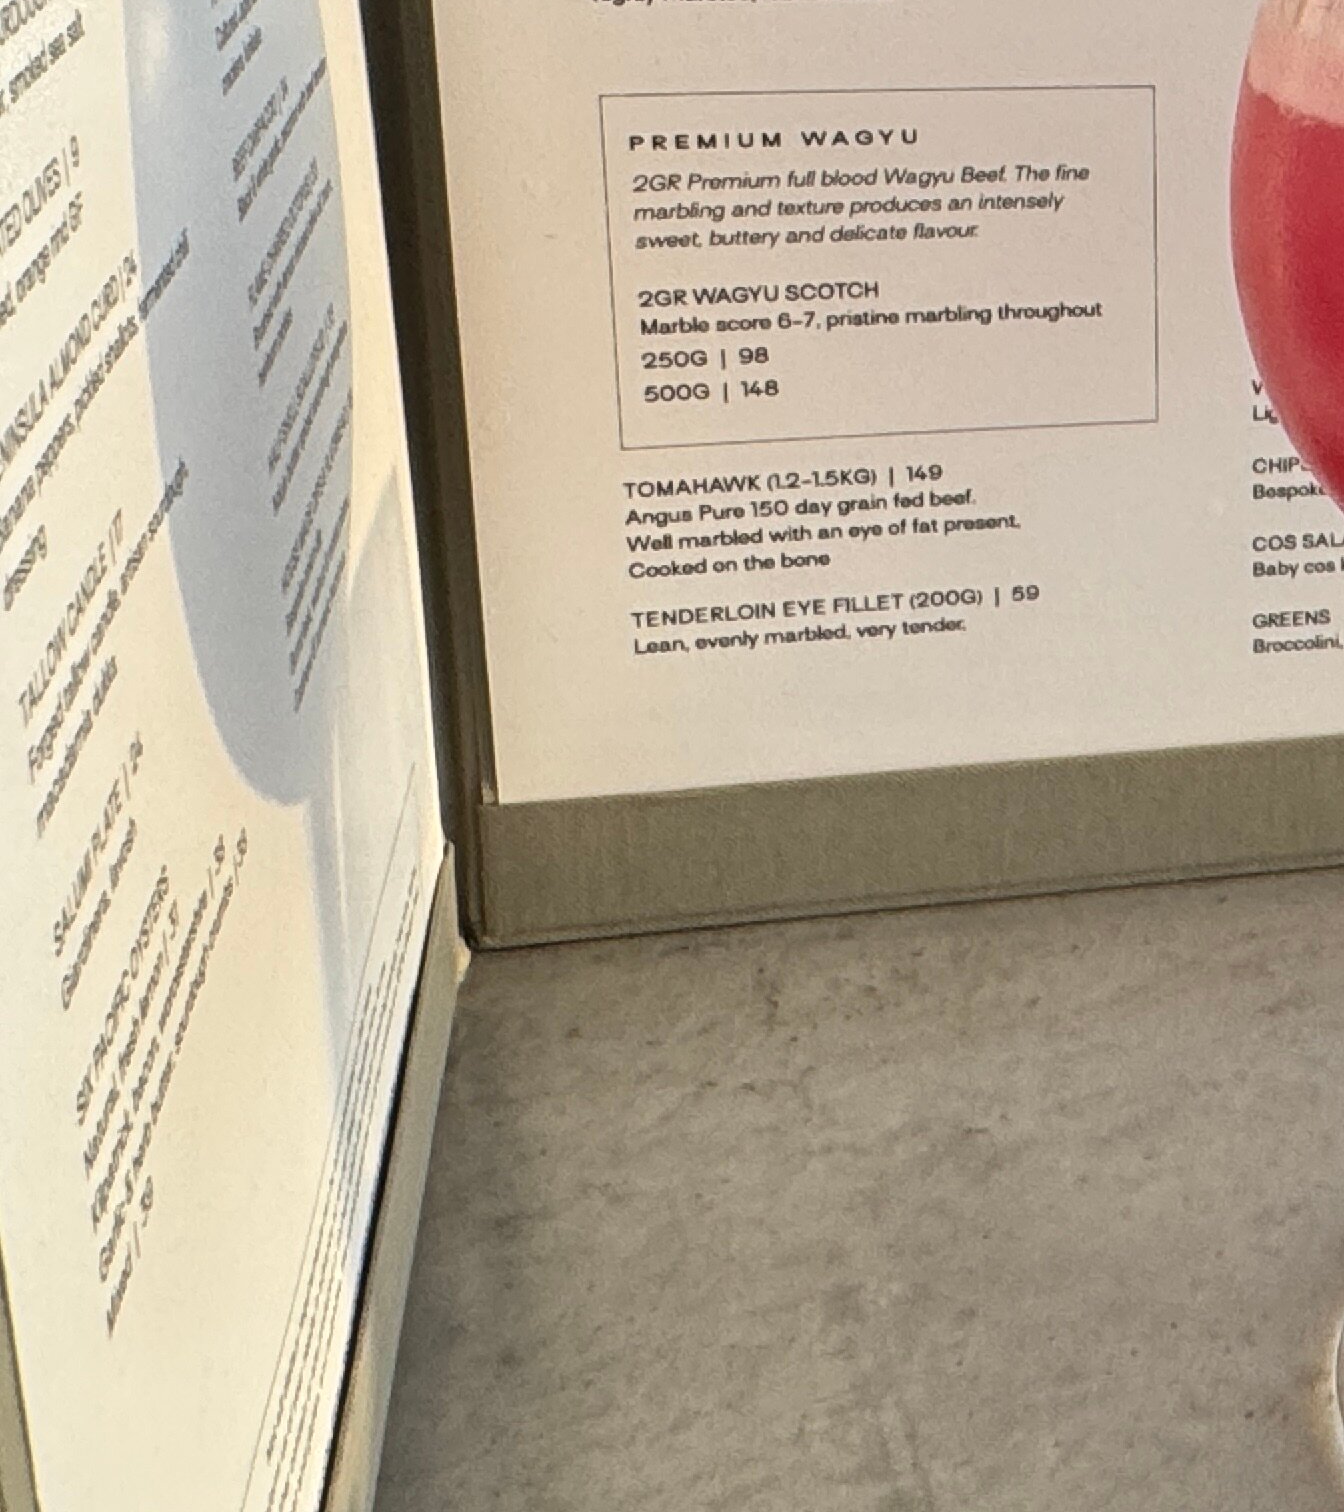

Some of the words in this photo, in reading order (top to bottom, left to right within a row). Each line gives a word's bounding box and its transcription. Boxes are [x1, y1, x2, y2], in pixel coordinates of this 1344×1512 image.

[628, 132, 782, 152] PREMIUM
[800, 128, 918, 147] WAGYU
[632, 173, 682, 194] 2GR
[686, 171, 782, 191] Premium
[786, 169, 817, 189] full
[820, 167, 879, 188] blood
[883, 167, 956, 190] Wagyu
[1014, 164, 1051, 182] The
[1054, 163, 1090, 182] fine
[633, 200, 726, 223] marbling
[730, 198, 773, 218] and
[776, 199, 845, 217] texture
[848, 195, 942, 220] produces
[946, 196, 973, 212] an
[977, 190, 1066, 213] intensely
[708, 229, 781, 250] buttery
[784, 224, 826, 244] and
[828, 224, 908, 244] delicate
[637, 288, 689, 308] 2GR
[691, 284, 780, 306] WAGYU
[784, 280, 880, 302] SCOTCH
[640, 316, 710, 336] Marble
[715, 316, 773, 333] score
[825, 309, 900, 332] pristine
[904, 304, 993, 326] marbling
[997, 301, 1103, 324] throughout
[640, 348, 708, 370] 250G
[738, 346, 770, 366] 98
[643, 382, 711, 404] 500G
[740, 378, 780, 398] 148
[622, 474, 762, 500] TOMAHAWK
[905, 464, 944, 482] 149
[624, 508, 694, 528] Angus
[698, 504, 746, 522] Pure
[749, 498, 790, 518] 150
[794, 498, 834, 518] day
[836, 493, 888, 518] grain
[892, 490, 925, 510] fed
[625, 532, 674, 553] Well
[678, 527, 764, 550] marbled
[768, 524, 813, 544] with
[817, 526, 844, 540] an
[847, 524, 884, 542] eye
[887, 518, 907, 536] of
[911, 516, 939, 534] fat
[1252, 533, 1298, 553] COS
[628, 556, 708, 580] Cooked
[712, 560, 738, 574] on
[742, 554, 776, 572] the
[780, 552, 832, 569] bone
[1252, 560, 1300, 579] Baby
[1303, 560, 1336, 575] cos
[630, 601, 776, 630] TENDERLOIN
[782, 598, 826, 618] EYE
[832, 592, 905, 614] FILLET
[908, 588, 984, 611] (200G)
[1011, 584, 1040, 602] 59
[1252, 608, 1332, 630] GREENS
[634, 638, 690, 656] Lean,
[694, 629, 760, 651] evenly
[763, 622, 852, 646] marbled,
[855, 624, 898, 640] very
[1252, 634, 1344, 654] Broccolini,
